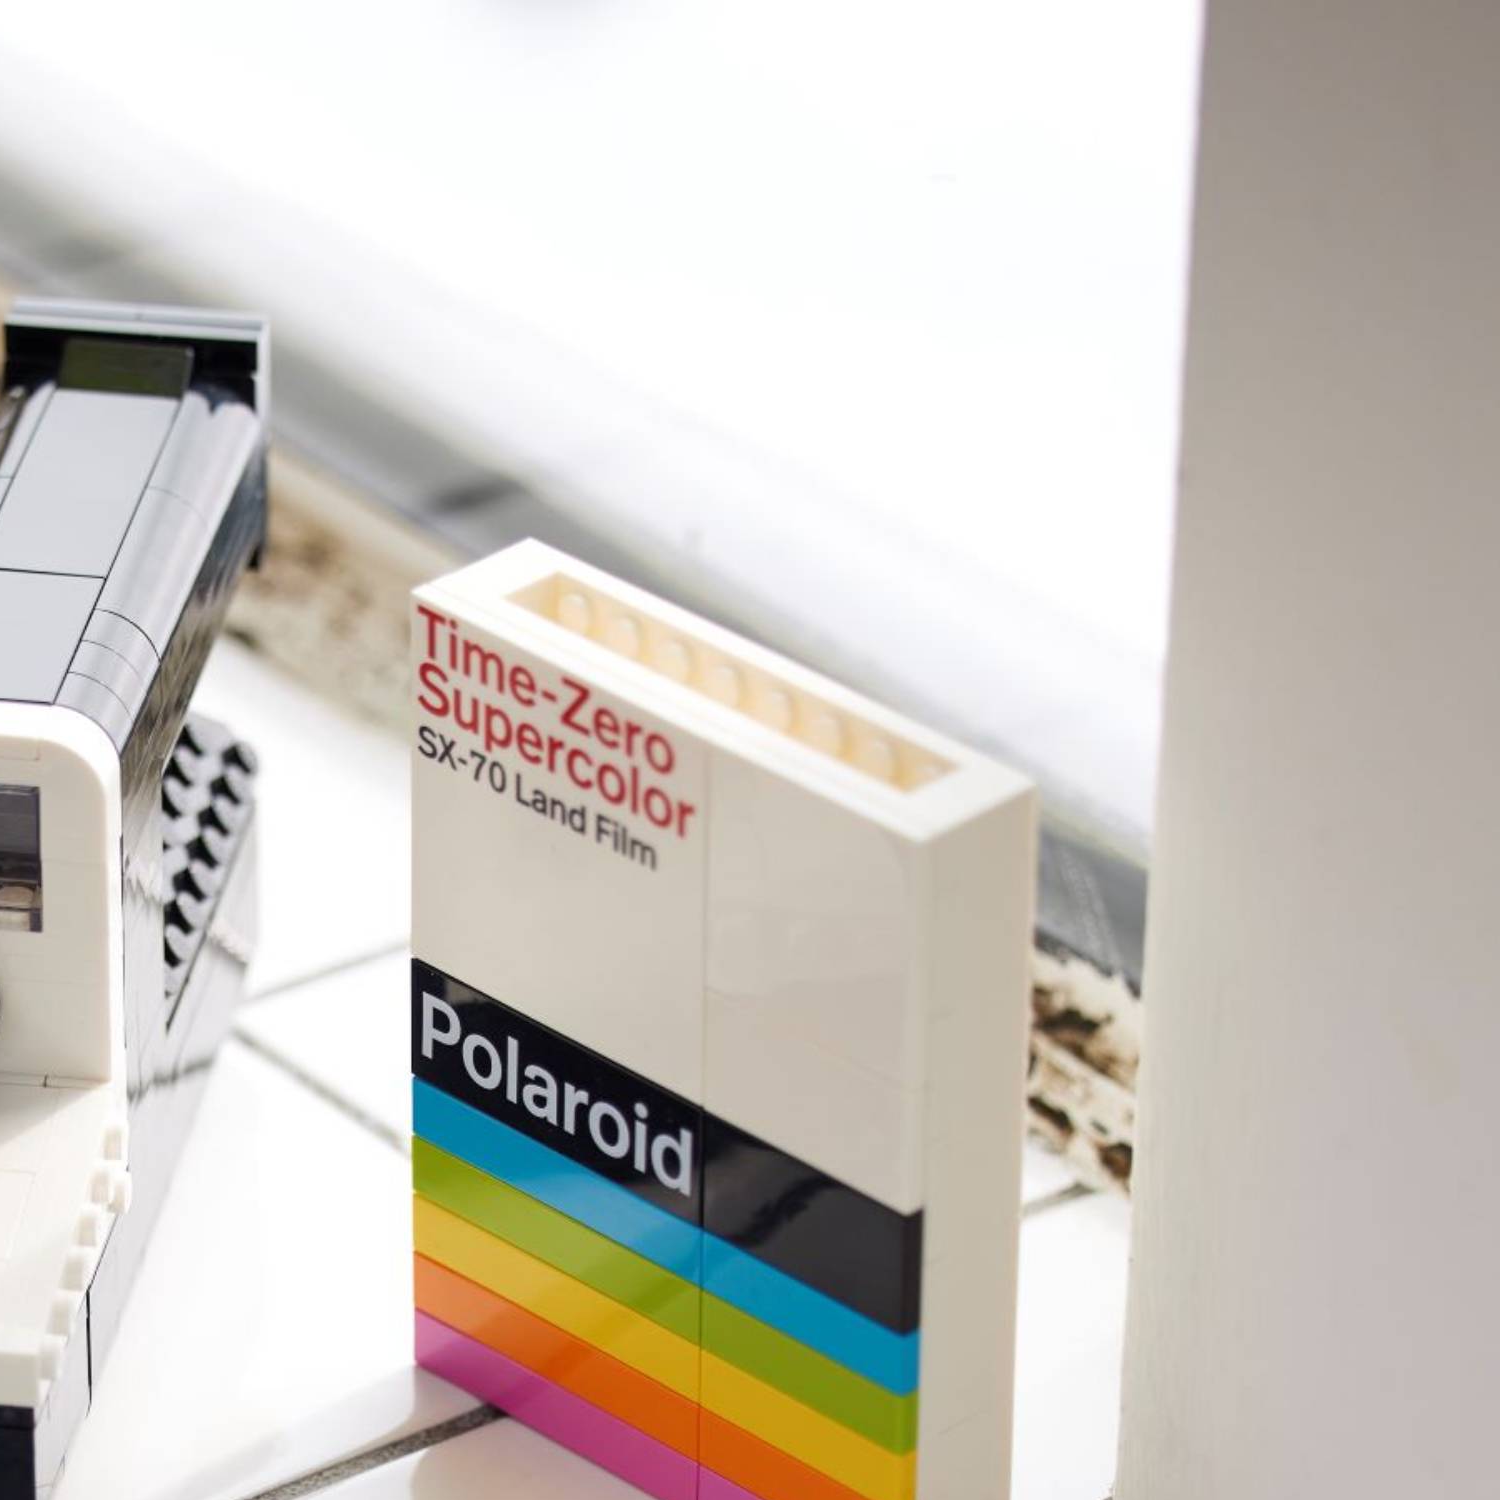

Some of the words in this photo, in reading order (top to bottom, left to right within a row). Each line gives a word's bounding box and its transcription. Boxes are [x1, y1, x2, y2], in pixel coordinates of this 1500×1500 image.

[417, 603, 676, 776] Time-Zero
[417, 661, 695, 840] Supercolor
[417, 724, 508, 795] SX-70
[514, 771, 587, 836] Land
[595, 811, 658, 872] Film
[420, 990, 694, 1199] Polaroid
